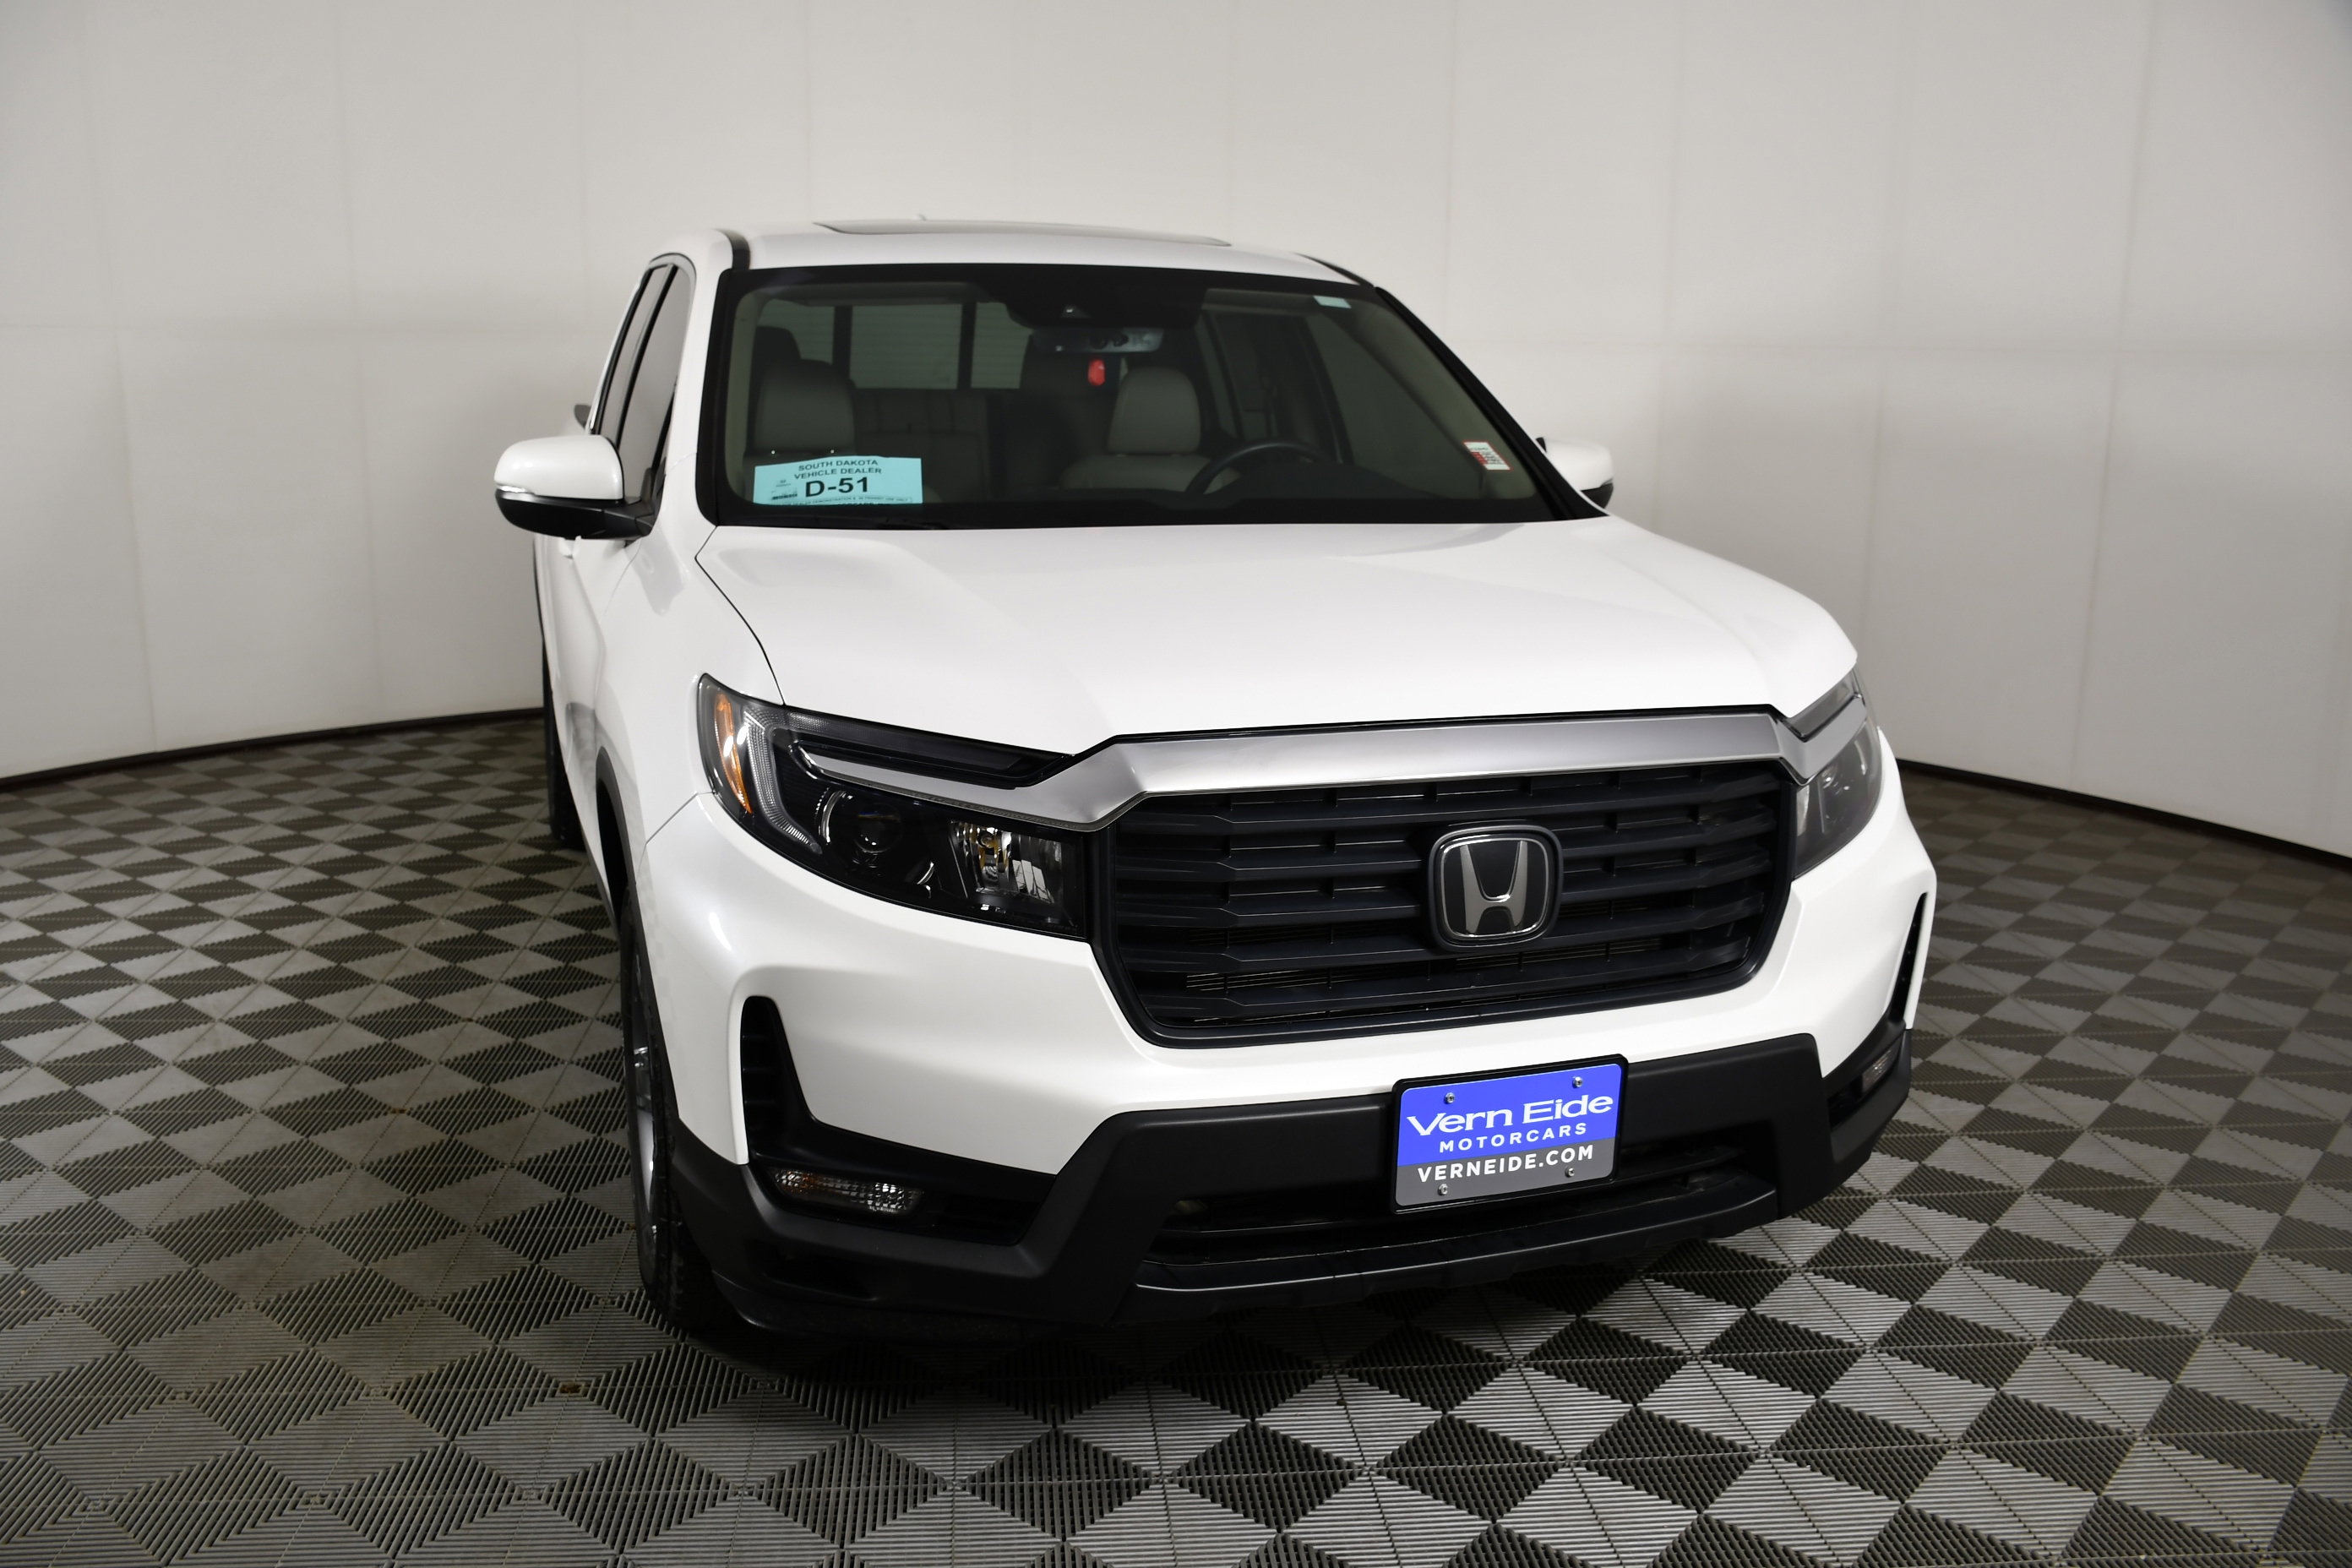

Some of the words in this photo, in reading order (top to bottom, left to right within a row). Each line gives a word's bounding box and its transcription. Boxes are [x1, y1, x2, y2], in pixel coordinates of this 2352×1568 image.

[793, 468, 837, 480] VEHICLE
[840, 466, 882, 475] DEALER
[798, 460, 833, 471] SOUTH
[805, 476, 868, 498] D-51
[1407, 1108, 1513, 1136] Vern
[1522, 1094, 1614, 1124] Eide
[1439, 1122, 1587, 1153] MOTORCARS
[1418, 1144, 1593, 1183] VERNEIDE.COM
